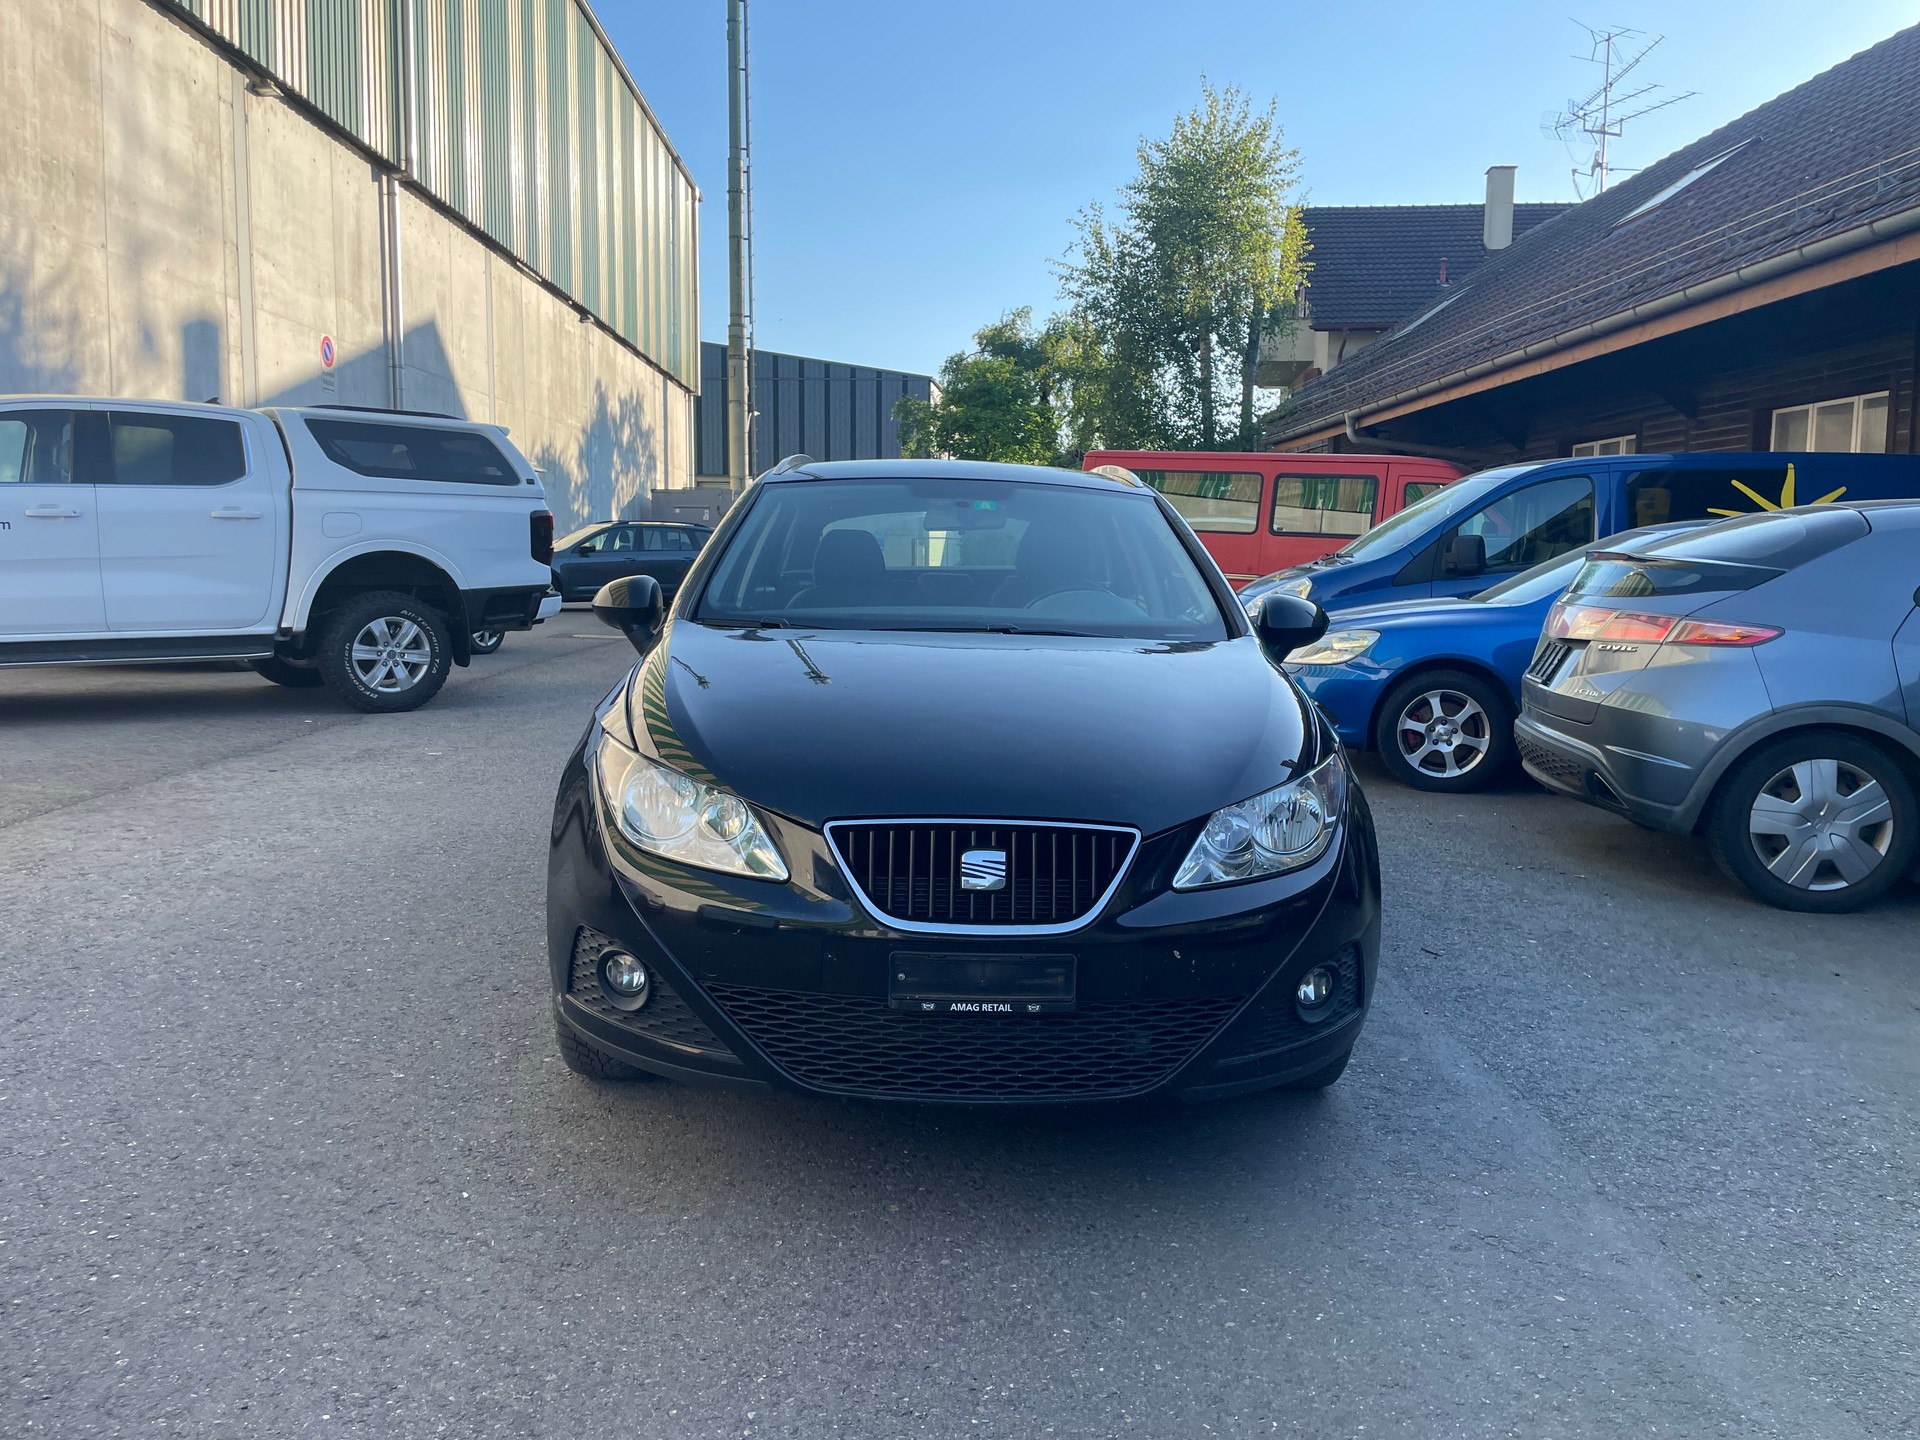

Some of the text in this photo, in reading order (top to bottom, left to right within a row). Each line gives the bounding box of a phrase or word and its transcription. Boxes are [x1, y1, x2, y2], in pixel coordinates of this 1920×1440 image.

[400, 609, 440, 674] All-Terrain T/A
[950, 1003, 1013, 1012] AMAG RETAIL
